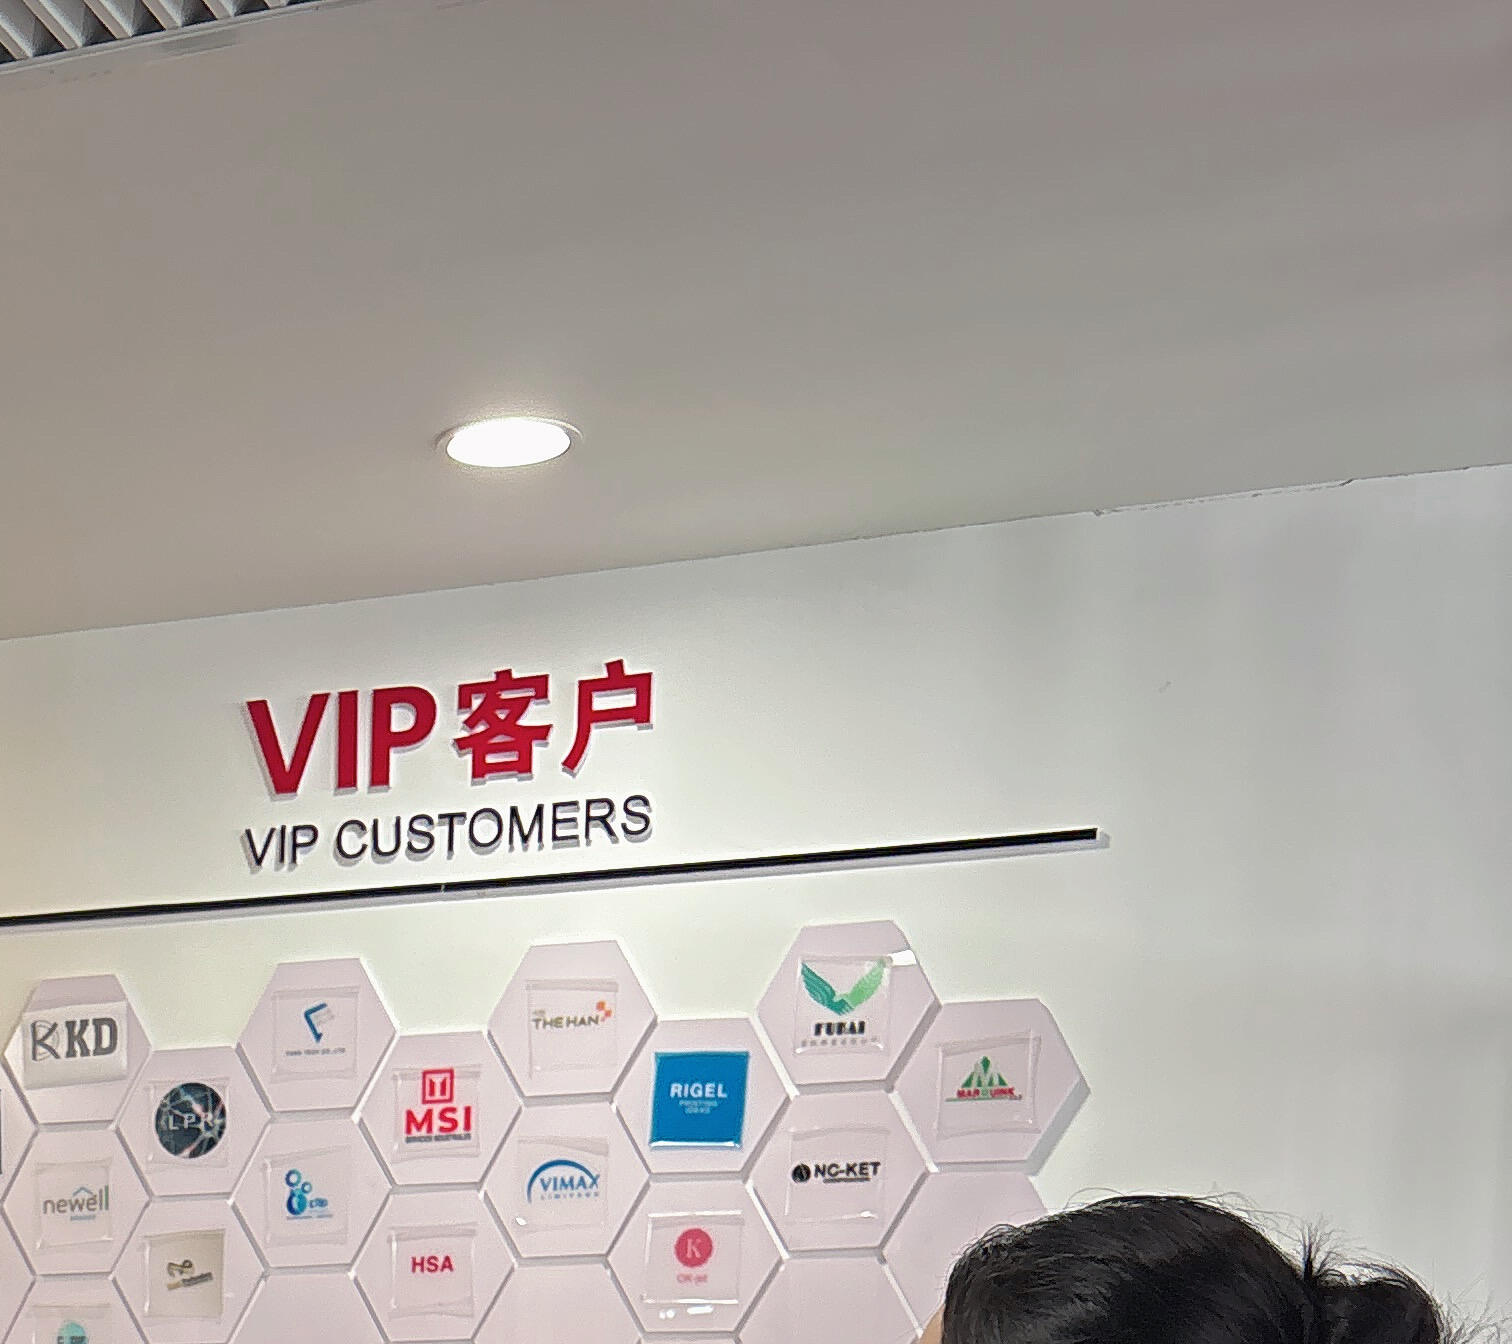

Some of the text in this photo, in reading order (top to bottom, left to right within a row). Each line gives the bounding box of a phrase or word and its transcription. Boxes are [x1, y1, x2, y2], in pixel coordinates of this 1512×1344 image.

[246, 658, 653, 796] VIP客户
[244, 794, 651, 867] VIP CUSTOMERS
[669, 1082, 728, 1099] RIGEL
[404, 1105, 473, 1136] MSI
[813, 1160, 882, 1179] NC-KET
[538, 1173, 601, 1193] VIMAX
[42, 1184, 110, 1215] newell
[410, 1255, 455, 1275] HSA
